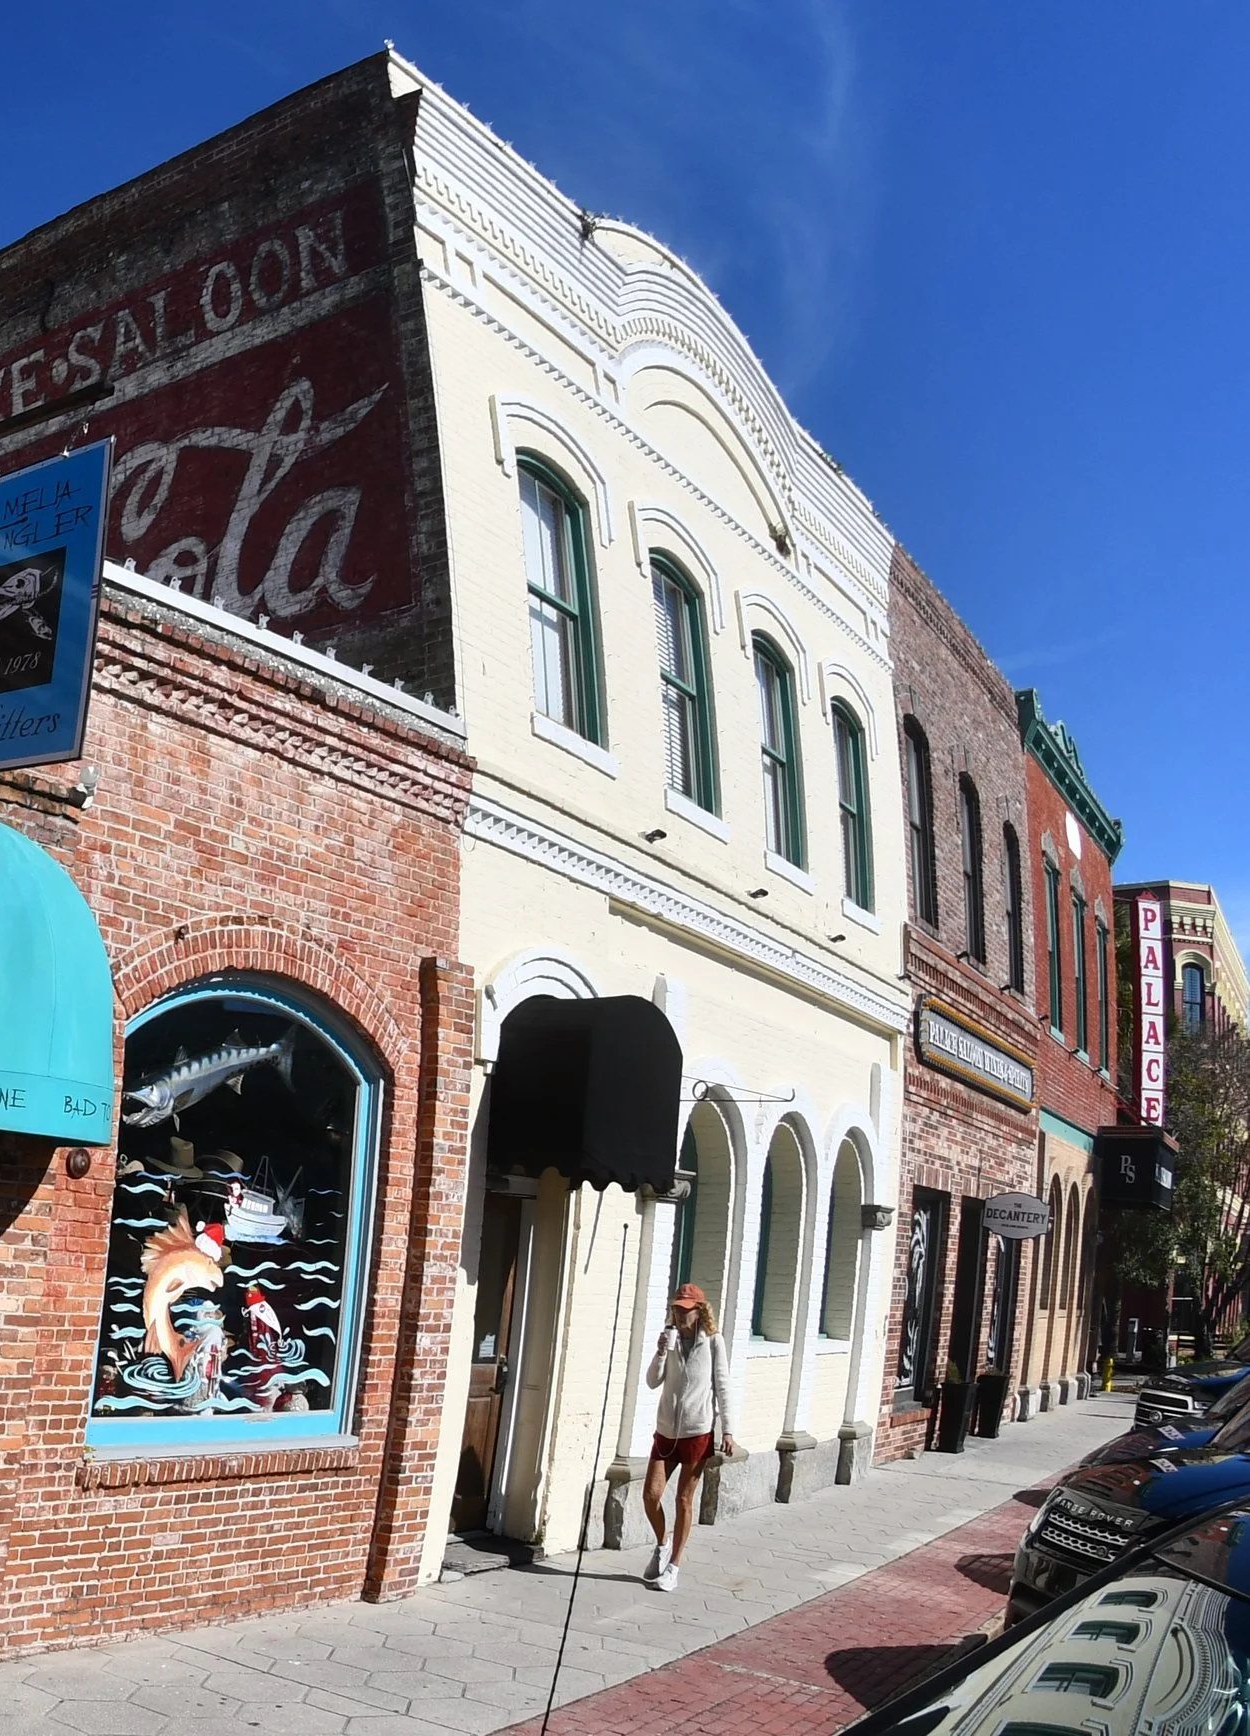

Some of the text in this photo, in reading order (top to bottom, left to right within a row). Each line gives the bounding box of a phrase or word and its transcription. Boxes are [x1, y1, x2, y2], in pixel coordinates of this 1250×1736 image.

[66, 209, 347, 388] SALOON
[4, 651, 41, 676] 1978
[1141, 907, 1162, 1123] PALACE
[929, 1020, 957, 1055] PALACE
[958, 1036, 983, 1068] SALOON
[63, 1095, 97, 1119] BAD
[985, 1207, 1047, 1225] DECANTERY
[1054, 1497, 1134, 1527] RANGE ROVER
